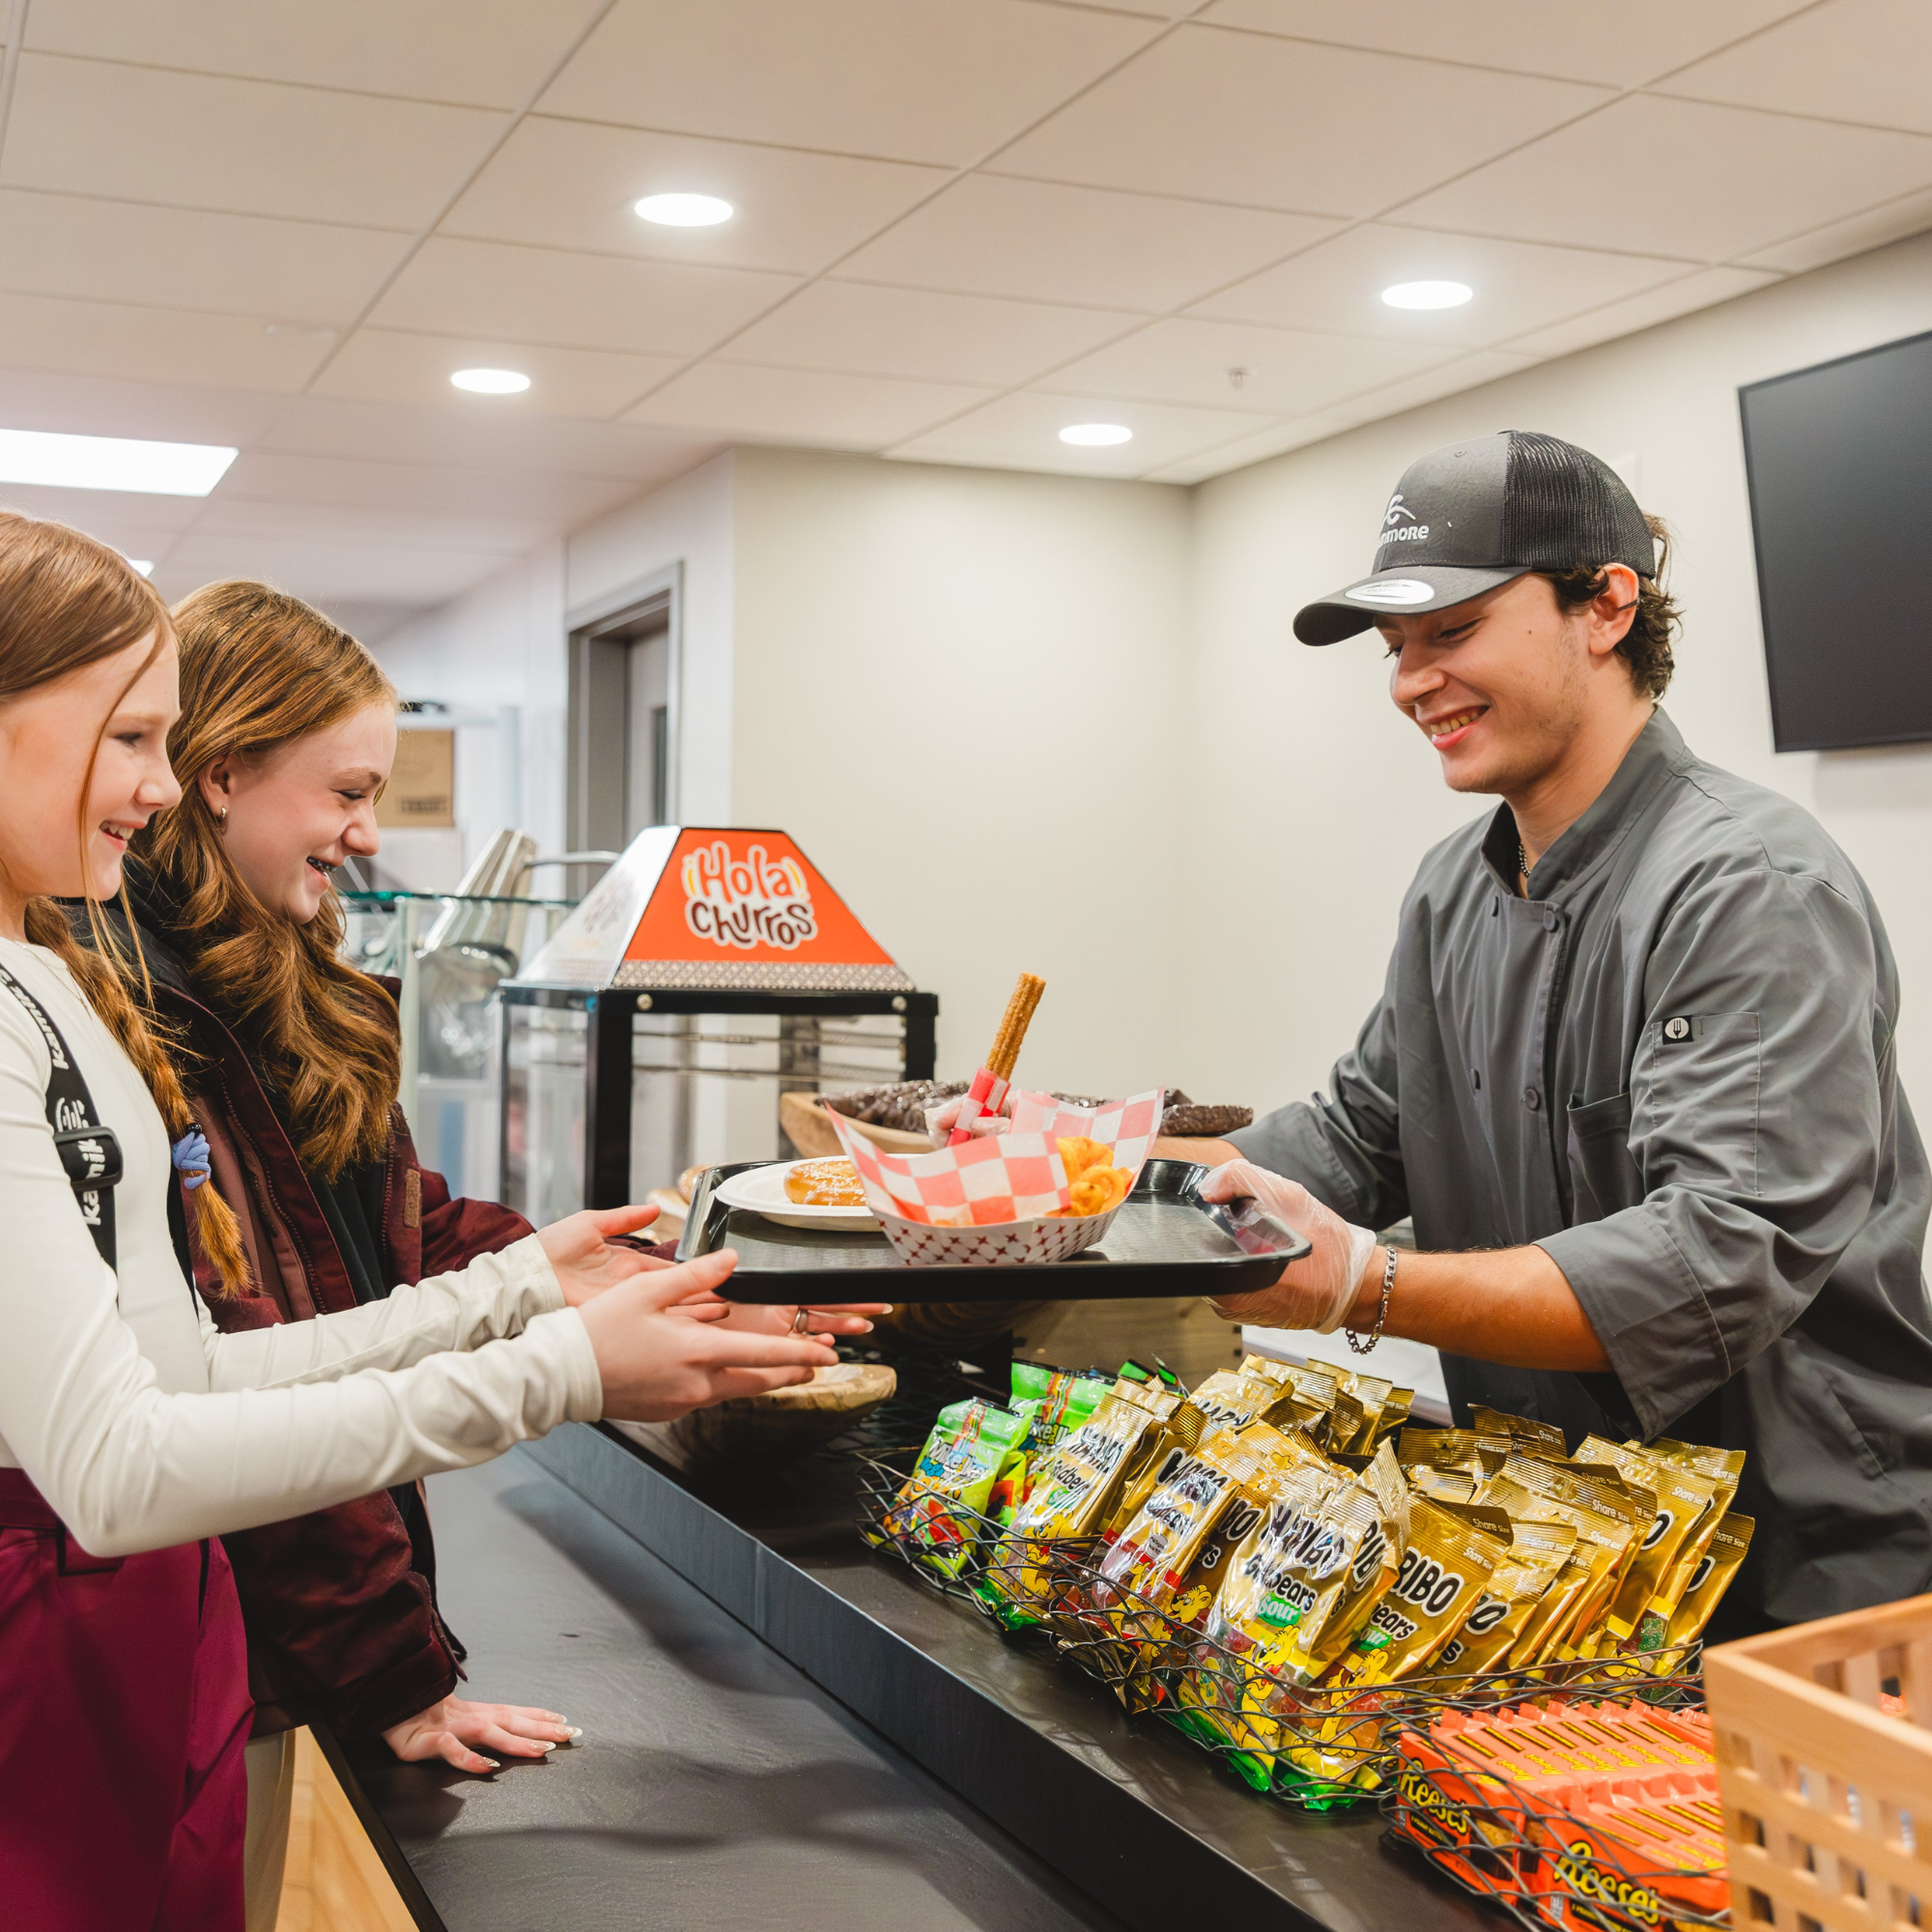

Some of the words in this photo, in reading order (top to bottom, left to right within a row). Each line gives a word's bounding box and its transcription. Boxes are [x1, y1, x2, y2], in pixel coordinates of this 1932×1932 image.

[691, 900, 813, 946] Churros
[1592, 1499, 1616, 1518] Share
[1472, 1518, 1497, 1532] Share
